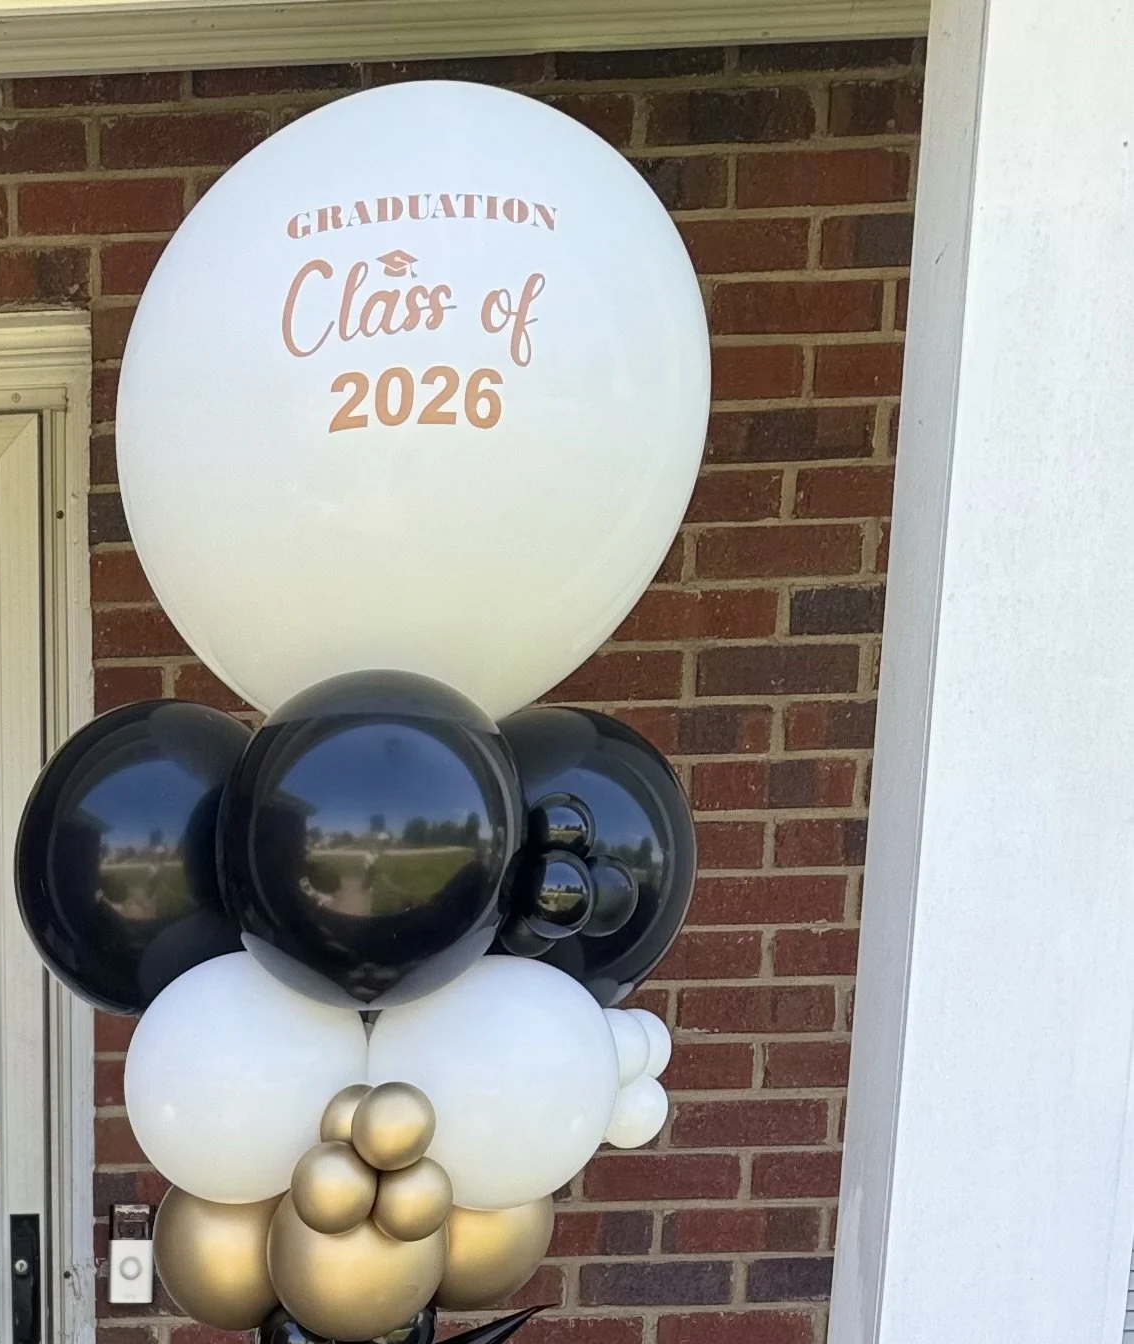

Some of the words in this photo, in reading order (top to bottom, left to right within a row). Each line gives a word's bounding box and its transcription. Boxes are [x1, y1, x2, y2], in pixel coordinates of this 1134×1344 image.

[287, 193, 558, 239] GRADUATION
[281, 259, 457, 357] Class
[481, 272, 545, 367] of
[328, 365, 504, 433] 2026
